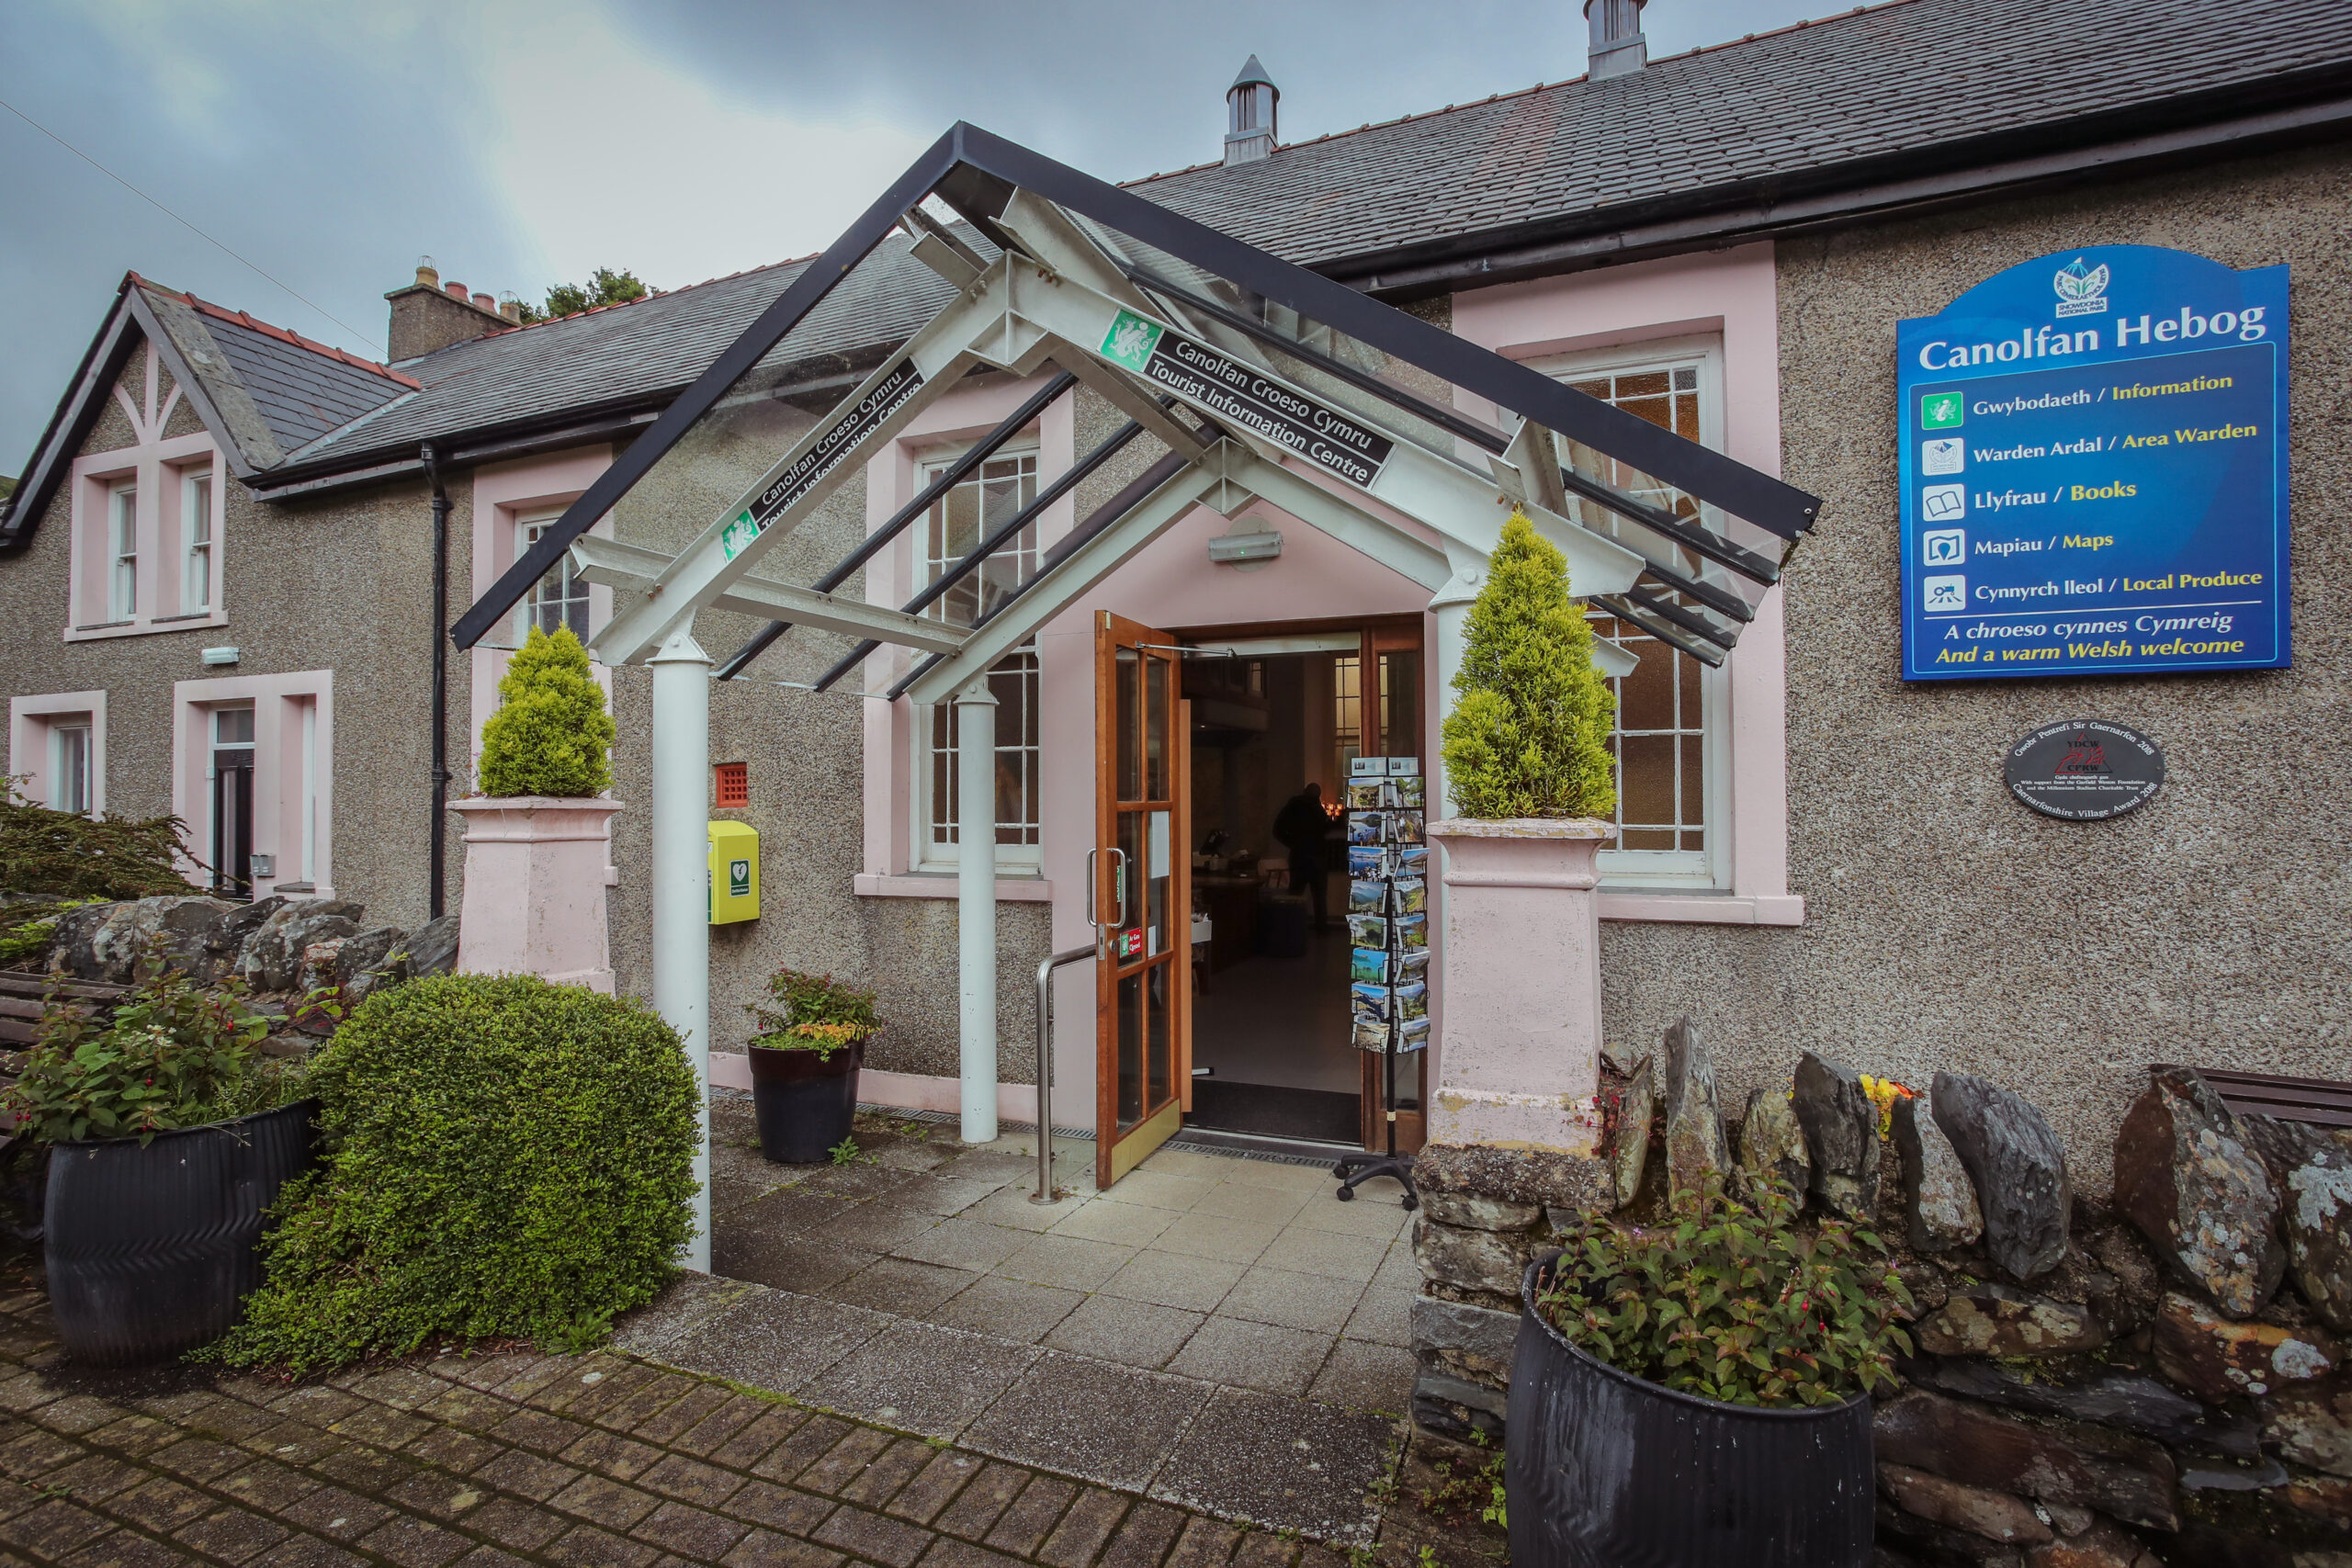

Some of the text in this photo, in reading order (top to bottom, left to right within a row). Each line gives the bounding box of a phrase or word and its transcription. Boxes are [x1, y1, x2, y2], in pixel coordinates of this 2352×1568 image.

[2058, 299, 2105, 310] SNOWDONIA
[2058, 308, 2088, 316] NATIONAL
[1918, 305, 2267, 371] Canolfan Hebog
[1175, 340, 1373, 450] Canolfan Croeso Cymru
[1973, 374, 2233, 417] Gwybodaeth / Information
[1152, 359, 1369, 482] Tourist Information Centre
[762, 371, 902, 505] Canolfan Croeso Cymru
[1973, 423, 2257, 463] Warden Ardal / Area Warden
[1974, 480, 2137, 512] Llyfrau / Books
[1974, 535, 2114, 558] Mapiau / Maps
[1975, 570, 2263, 604] Cynnyrch lleol / Local Produce
[1944, 612, 2233, 640] A chroeso cynnes Cymreig
[1936, 637, 2245, 664] And a warm Welsh welcome
[2014, 722, 2154, 757] Gwobr Pentrefi Sir Gaernarfon 2018
[2067, 740, 2101, 749] YDCW
[2013, 782, 2158, 818] Caernarfonshire Village Award 2018
